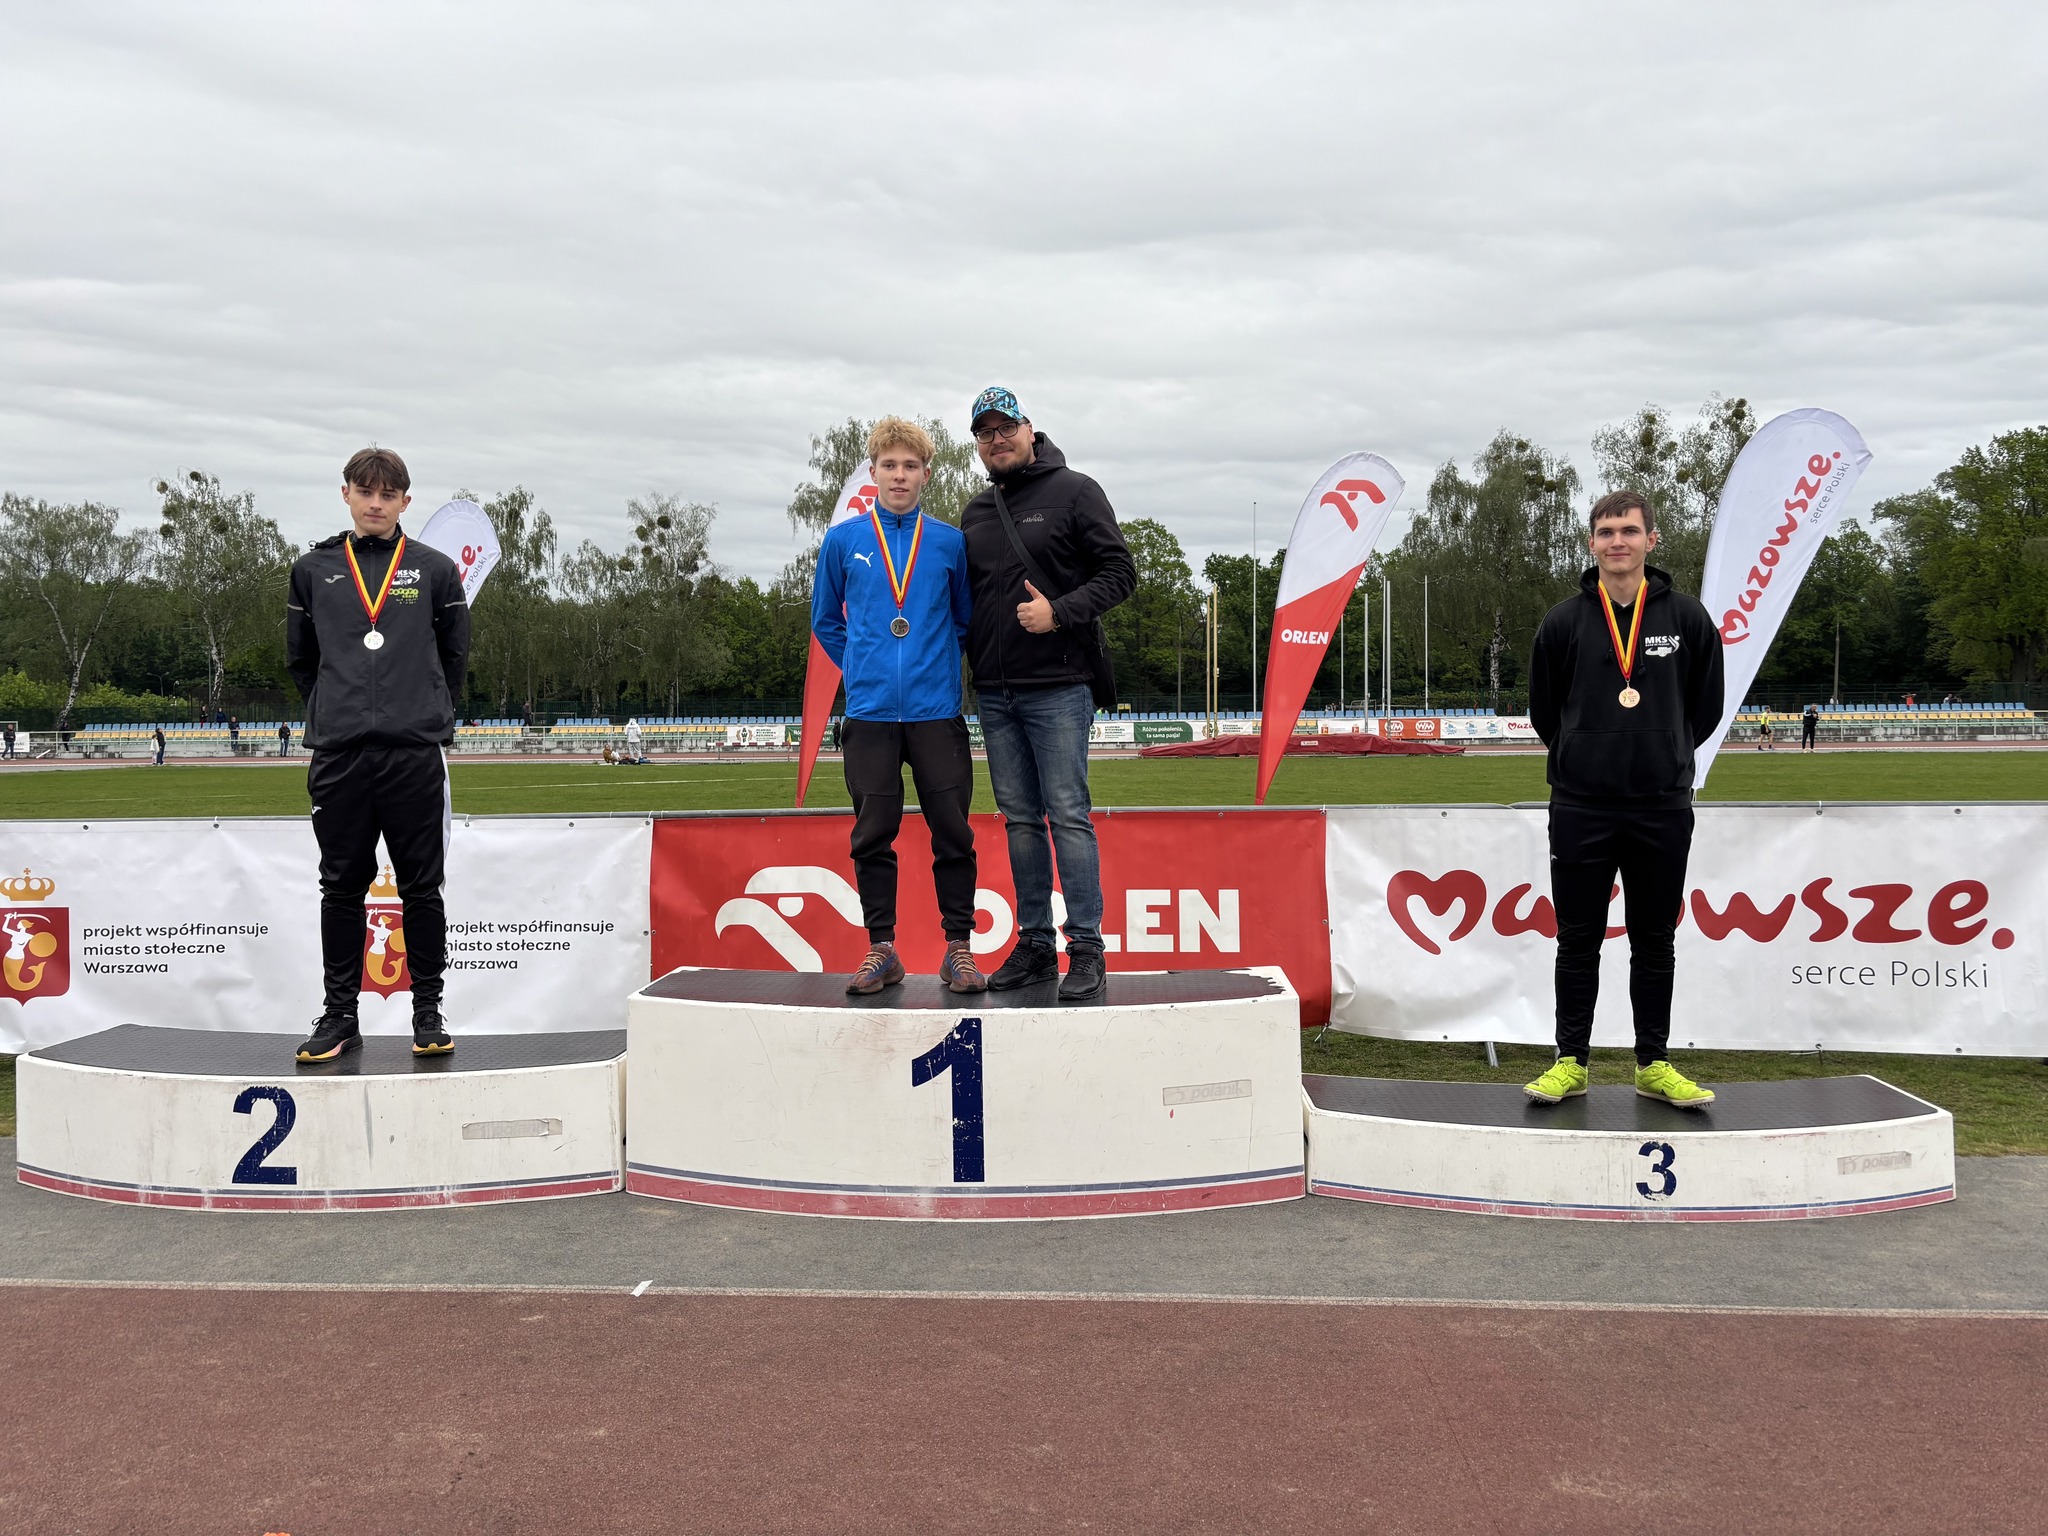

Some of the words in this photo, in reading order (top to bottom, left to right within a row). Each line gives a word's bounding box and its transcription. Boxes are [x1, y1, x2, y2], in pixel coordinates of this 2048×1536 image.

[1810, 494, 1831, 524] serce
[1825, 462, 1850, 494] Polski
[469, 556, 487, 583] Polski
[1281, 628, 1329, 645] ORLEN
[1645, 635, 1668, 645] MKS
[970, 888, 1240, 954] OEN
[1387, 869, 2015, 955] Mawsze.
[83, 924, 142, 940] projekt
[146, 923, 269, 938] współfinansuje
[497, 920, 615, 936] współfinansuje
[83, 943, 141, 956] miasto
[144, 942, 226, 954] stołeczne
[496, 939, 571, 951] stołeczne
[83, 962, 168, 974] Warszawa
[1791, 964, 1876, 986] serce
[1891, 960, 1988, 988] Polski
[912, 1018, 985, 1182] 1
[232, 1086, 297, 1185] 2
[1636, 1141, 1677, 1201] 3
